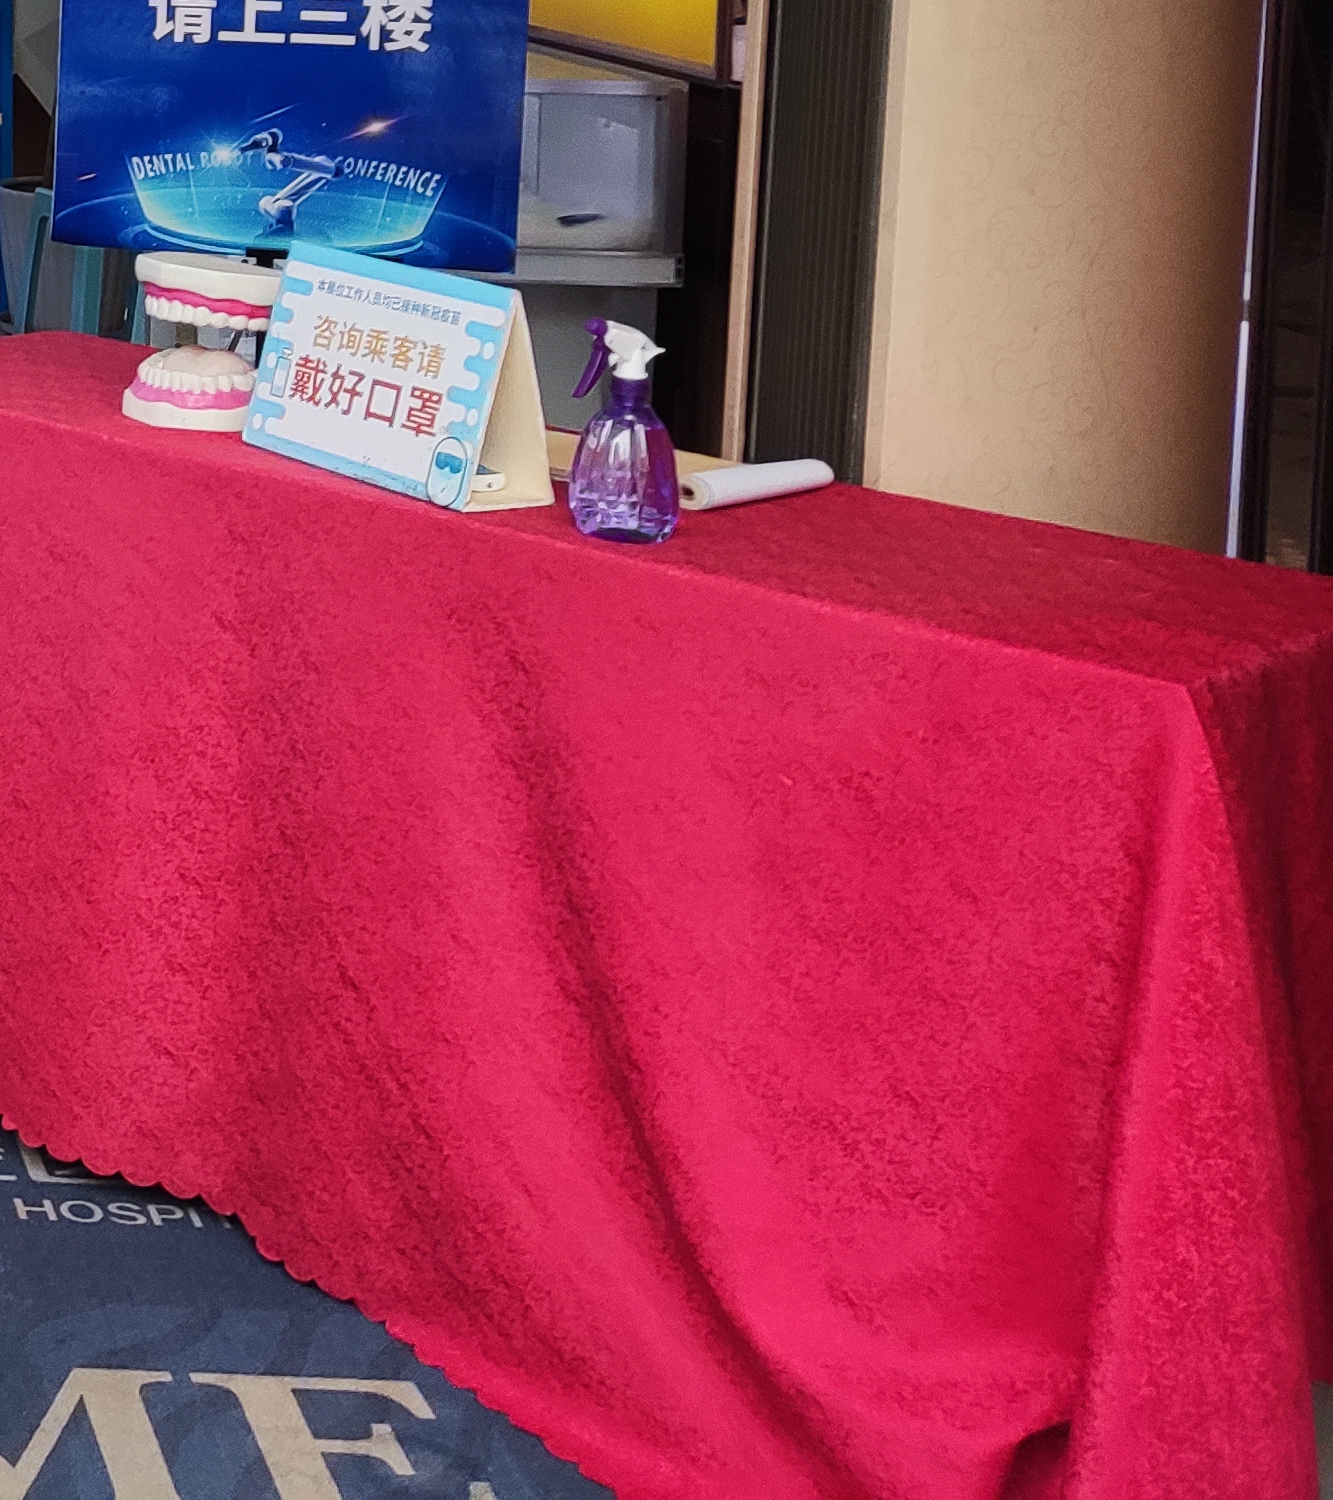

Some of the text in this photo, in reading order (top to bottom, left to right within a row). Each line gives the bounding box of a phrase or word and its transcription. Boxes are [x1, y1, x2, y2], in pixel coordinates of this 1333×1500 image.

[131, 150, 195, 181] DENTAL
[313, 313, 447, 379] 咨询乘客请
[289, 354, 444, 438] 戴好口罩
[14, 1198, 233, 1230] HOSPI
